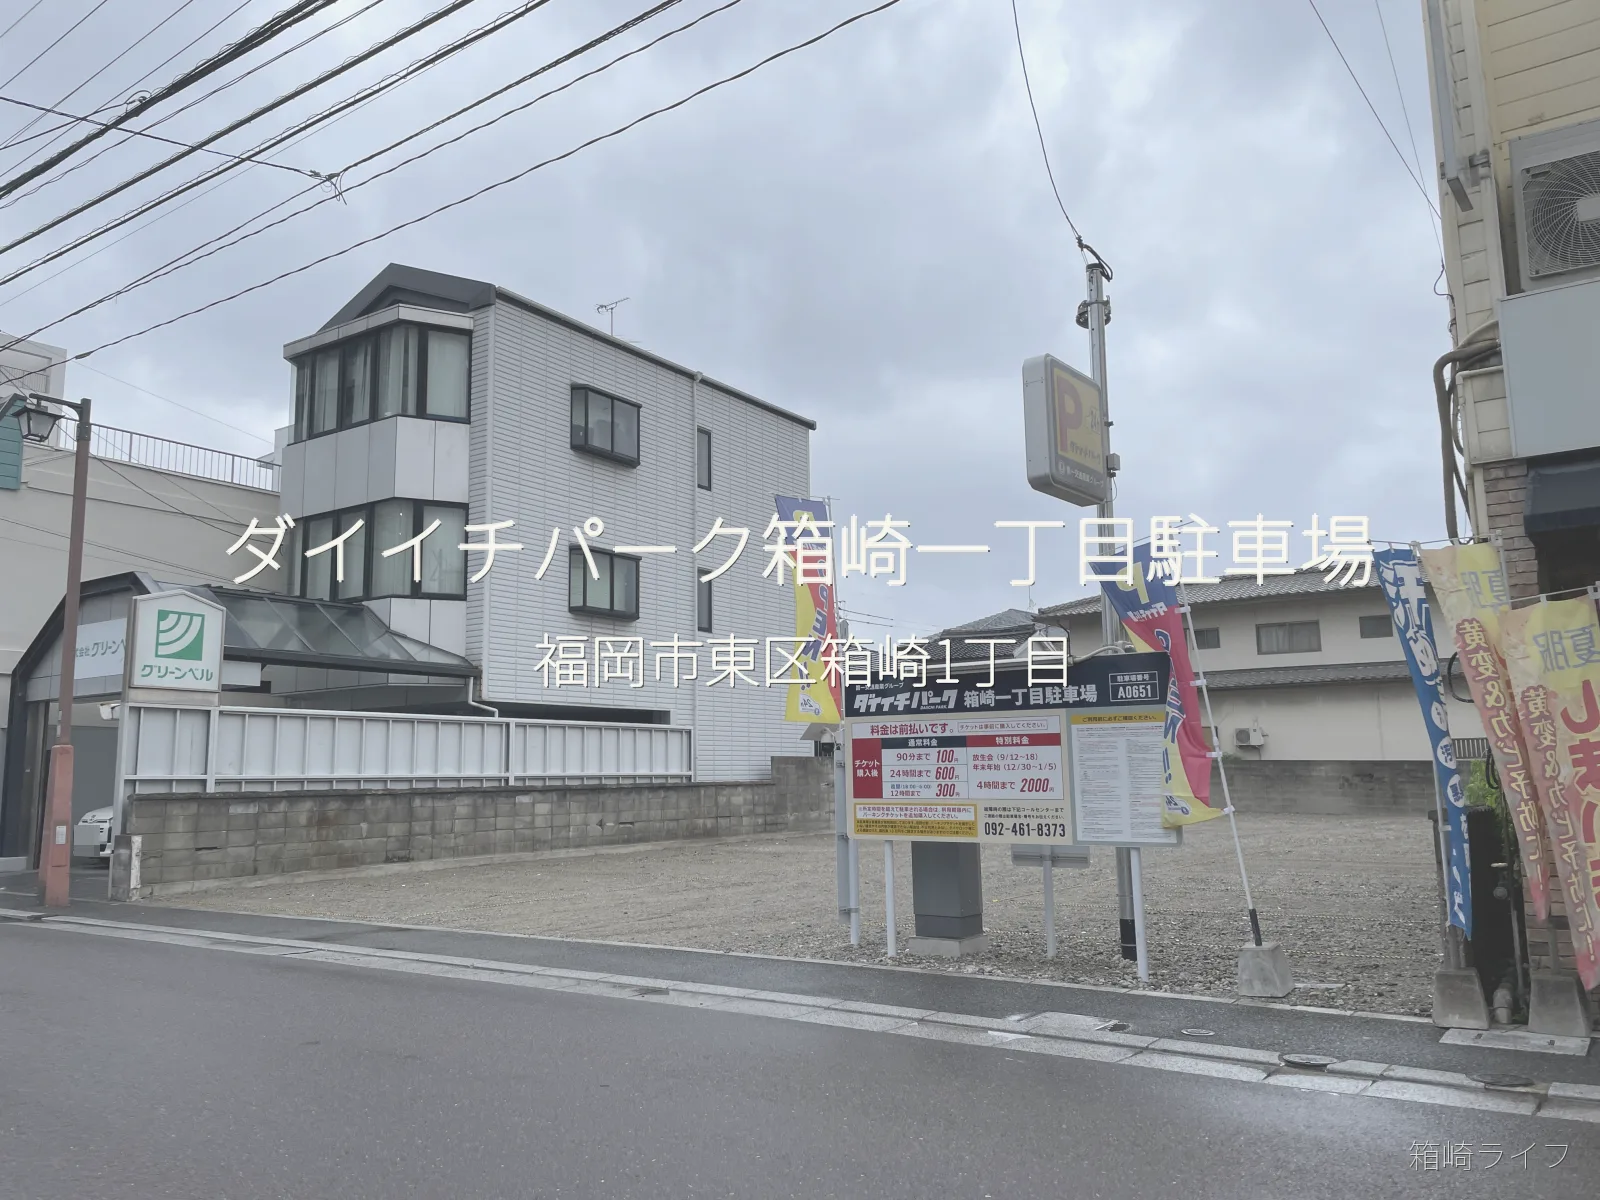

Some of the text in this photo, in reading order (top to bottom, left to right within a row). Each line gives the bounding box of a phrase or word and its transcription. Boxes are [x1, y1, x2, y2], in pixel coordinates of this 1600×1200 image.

[1056, 374, 1083, 454] P
[963, 684, 1098, 708] 箱崎一丁目駐車場
[1117, 684, 1152, 699] A0651
[853, 689, 958, 713] ダイイチパーク
[870, 722, 954, 736] 料金は前払いです。
[907, 738, 938, 747] 通常料金
[995, 736, 1030, 745] 特別料金
[854, 759, 880, 768] チケット
[896, 749, 959, 764] 90分まで 100円
[856, 769, 879, 778] 購入後
[889, 766, 960, 781] 24時間まで 600円
[976, 778, 1055, 793] 4時間まで 2000円
[984, 821, 1066, 837] 092-461-8373
